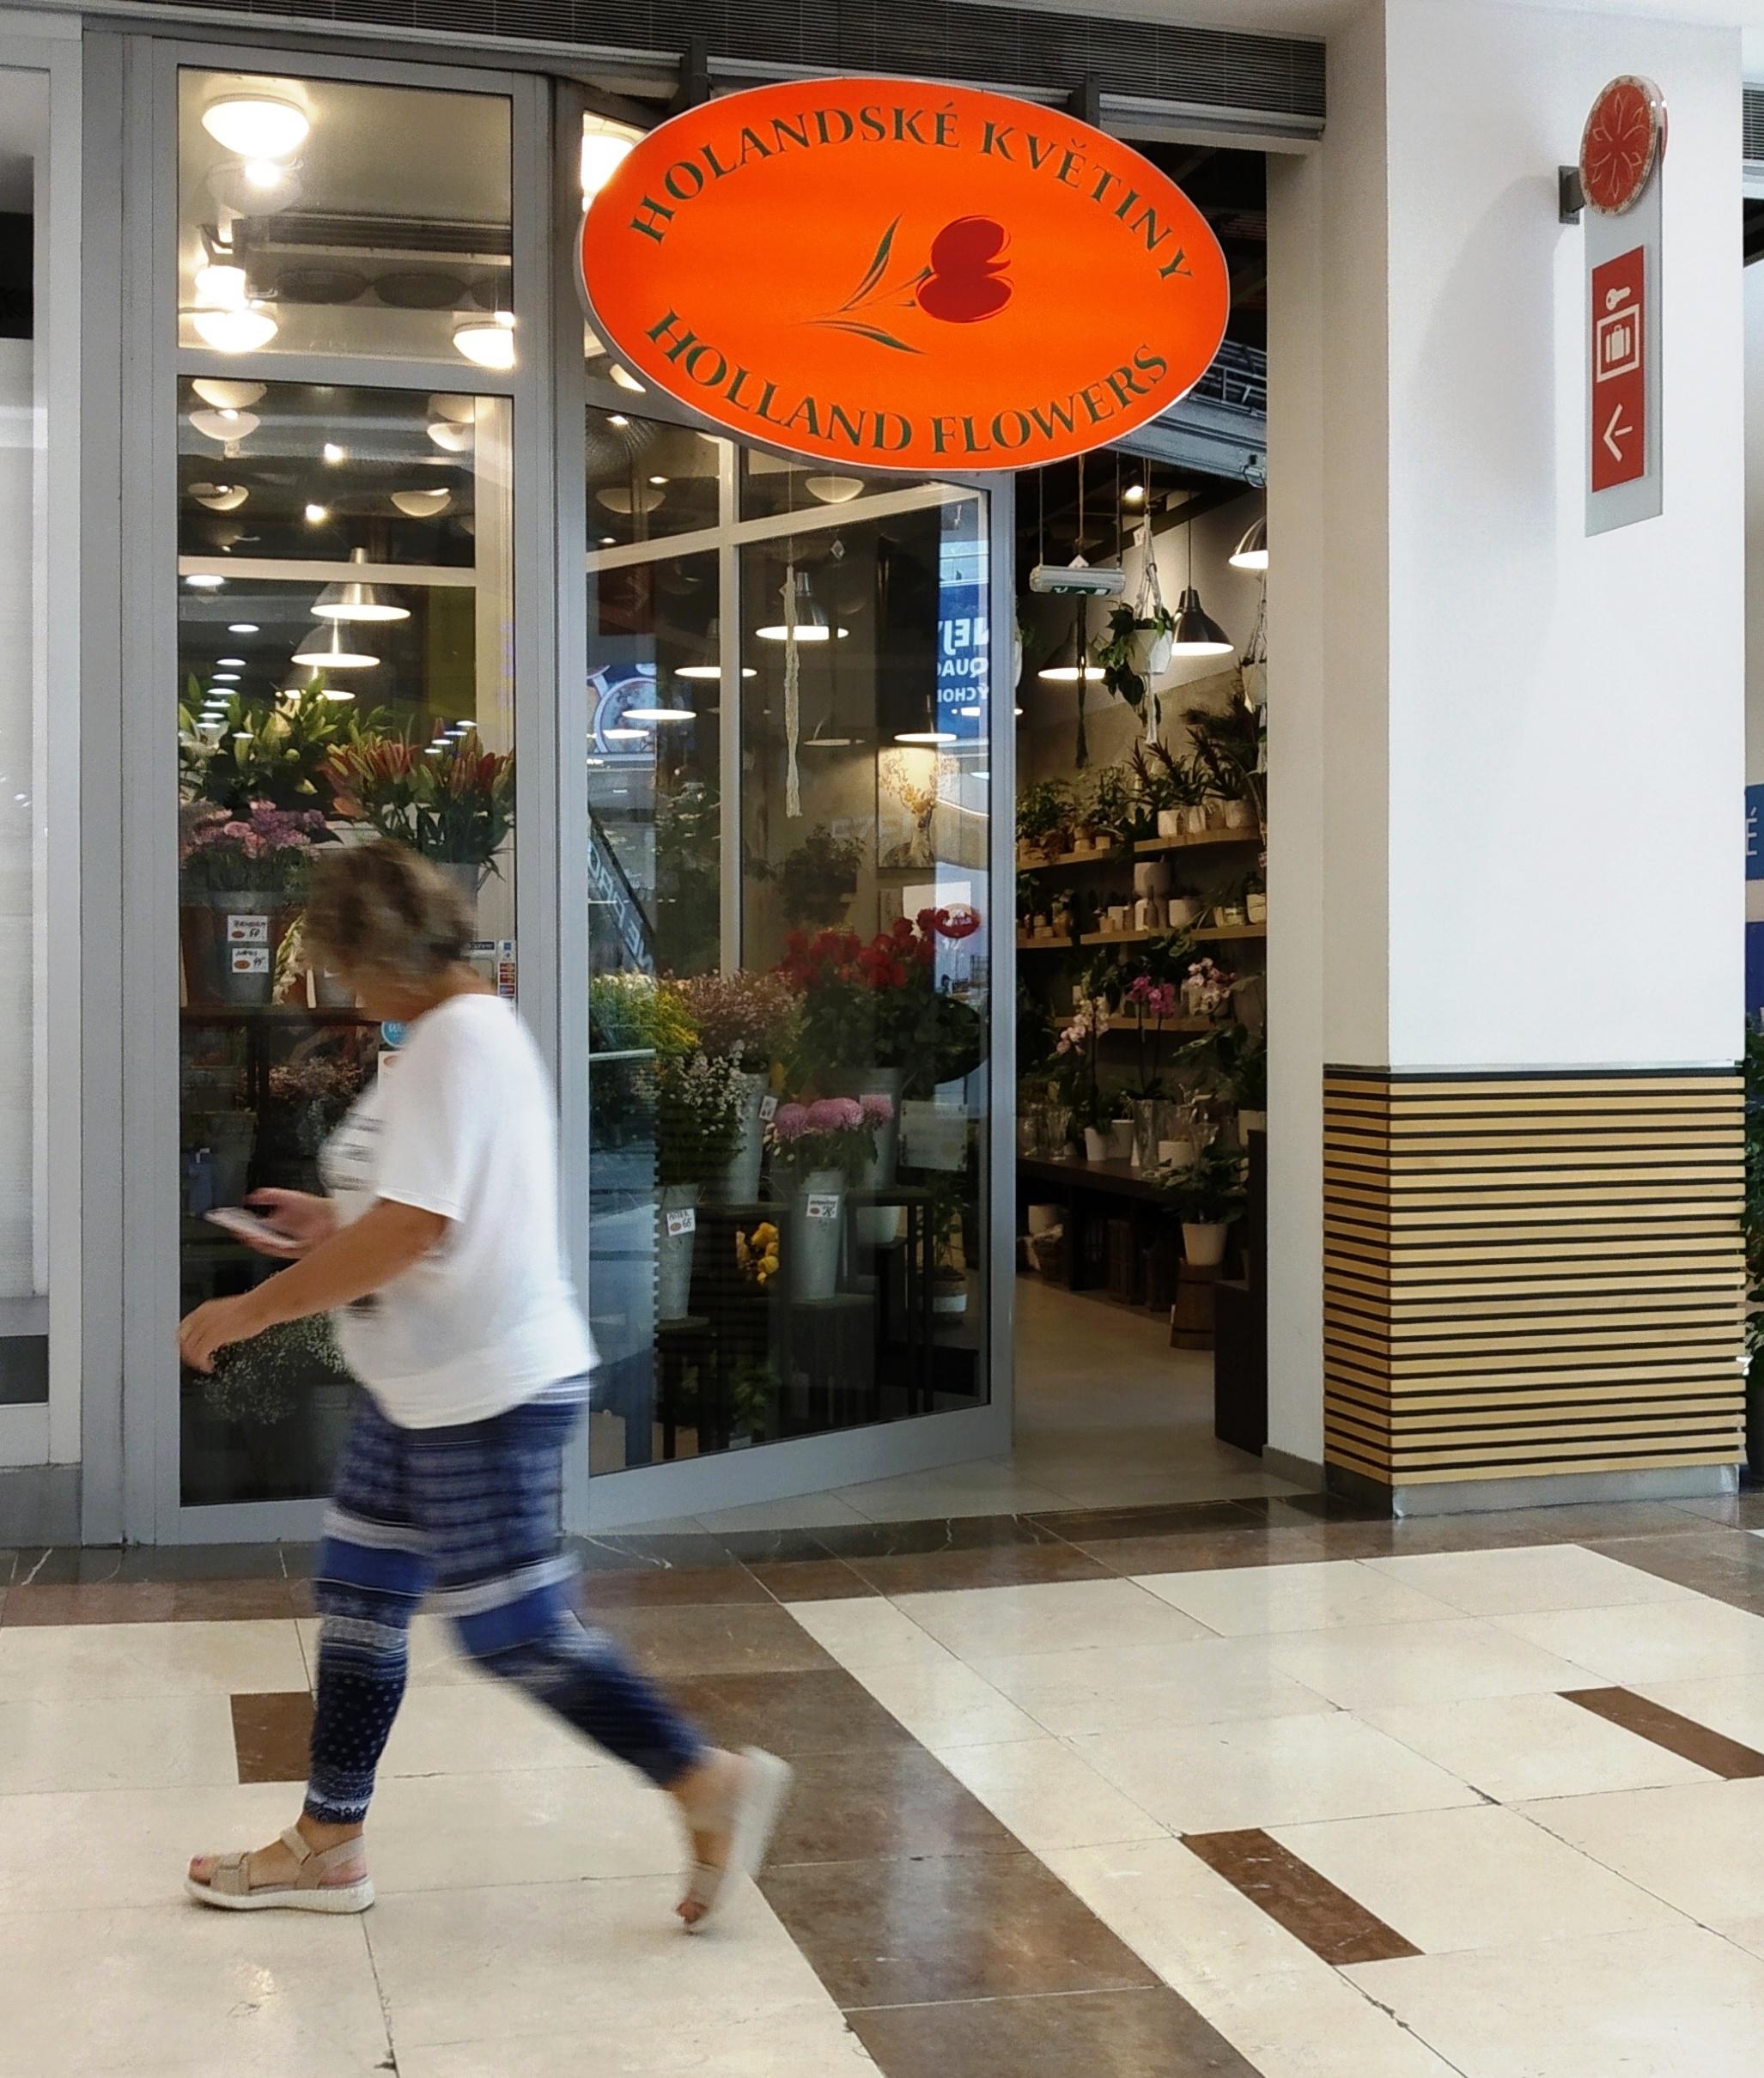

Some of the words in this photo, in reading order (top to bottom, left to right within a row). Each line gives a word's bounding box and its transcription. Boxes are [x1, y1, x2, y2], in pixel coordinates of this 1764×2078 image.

[630, 101, 959, 246] HOLANDSKÉ
[979, 119, 1193, 280] KVĚTINY
[645, 308, 912, 451] HOLLAND
[930, 343, 1167, 453] FLOWERS
